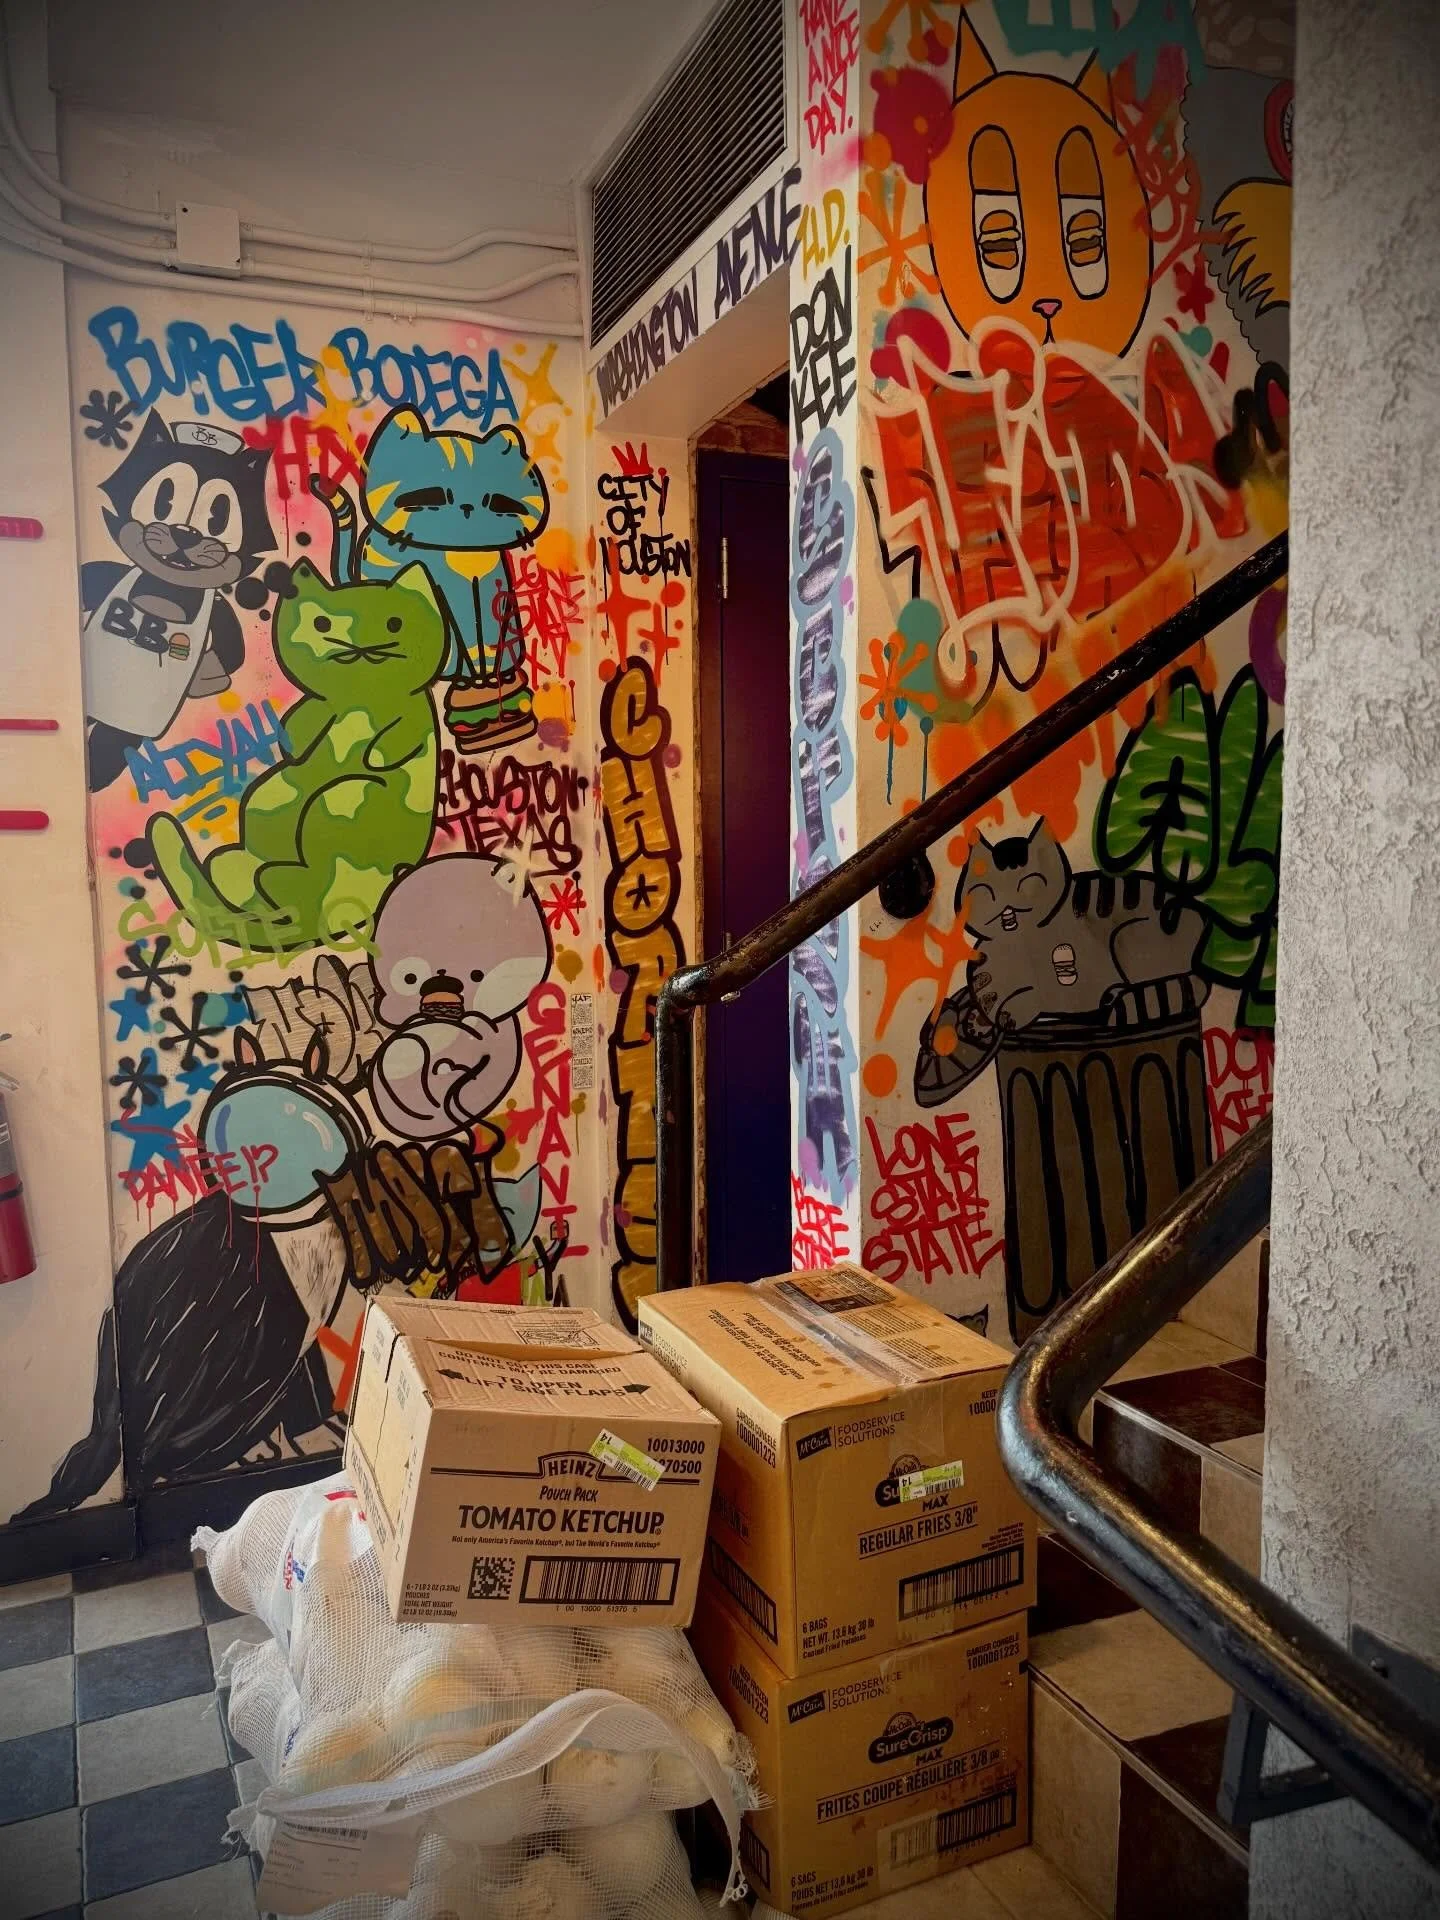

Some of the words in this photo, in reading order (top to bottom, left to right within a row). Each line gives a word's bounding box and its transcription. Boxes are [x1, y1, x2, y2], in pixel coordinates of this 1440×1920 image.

[790, 245, 852, 372] DON
[88, 306, 327, 422] BURGER
[327, 327, 520, 432] BODEGA
[791, 341, 857, 443] KEE
[598, 473, 669, 517] CITY
[606, 500, 646, 541] OF
[599, 533, 692, 577] HOUSTON
[101, 597, 170, 653] BB
[439, 749, 580, 817] HOUSTON
[434, 803, 583, 877] TEXAS
[865, 1112, 980, 1180] LONE
[870, 1160, 985, 1230] STAR
[861, 1197, 1006, 1284] STATE
[438, 1351, 506, 1370] CONTENTS
[455, 1350, 473, 1358] DO
[464, 1376, 505, 1389] LIFT
[514, 1384, 556, 1395] SIDE
[566, 1389, 628, 1397] FLAPS
[496, 1375, 522, 1386] TO
[531, 1381, 583, 1389] OPEN
[981, 1389, 998, 1399] KEEP
[837, 1411, 905, 1436] FOODSERVICE
[838, 1424, 896, 1448] SOLUTIONS
[647, 1437, 705, 1454] 10013000
[736, 1420, 776, 1468] 1000001223
[799, 1433, 830, 1456] McCain
[548, 1459, 597, 1478] HEINZ
[540, 1485, 570, 1501] POUCH
[574, 1487, 598, 1503] PACK
[922, 1493, 949, 1513] MAX
[458, 1504, 557, 1532] TOMATO
[859, 1525, 914, 1555] REGULAR
[917, 1513, 951, 1538] FRIES
[954, 1506, 978, 1527] 3/8"
[479, 1537, 508, 1545] America's
[802, 1621, 808, 1634] 6
[809, 1616, 828, 1632] BAGS
[802, 1635, 816, 1650] NET
[818, 1631, 830, 1645] WT.
[847, 1623, 857, 1636] kg
[967, 1642, 1020, 1671] 1000001223
[739, 1664, 751, 1682] KEEP
[751, 1679, 769, 1708] FROZEN
[832, 1671, 903, 1698] FOODSERVICE
[790, 1698, 824, 1720] McCain
[875, 1725, 948, 1758] SureCrisp
[915, 1746, 944, 1767] MAX
[817, 1792, 860, 1821] FRITES
[863, 1780, 904, 1806] COUPE
[970, 1750, 988, 1769] 3/8
[791, 1876, 796, 1888] 6
[797, 1871, 816, 1885] SACS
[792, 1886, 814, 1901] POIDS
[815, 1881, 828, 1895] NET
